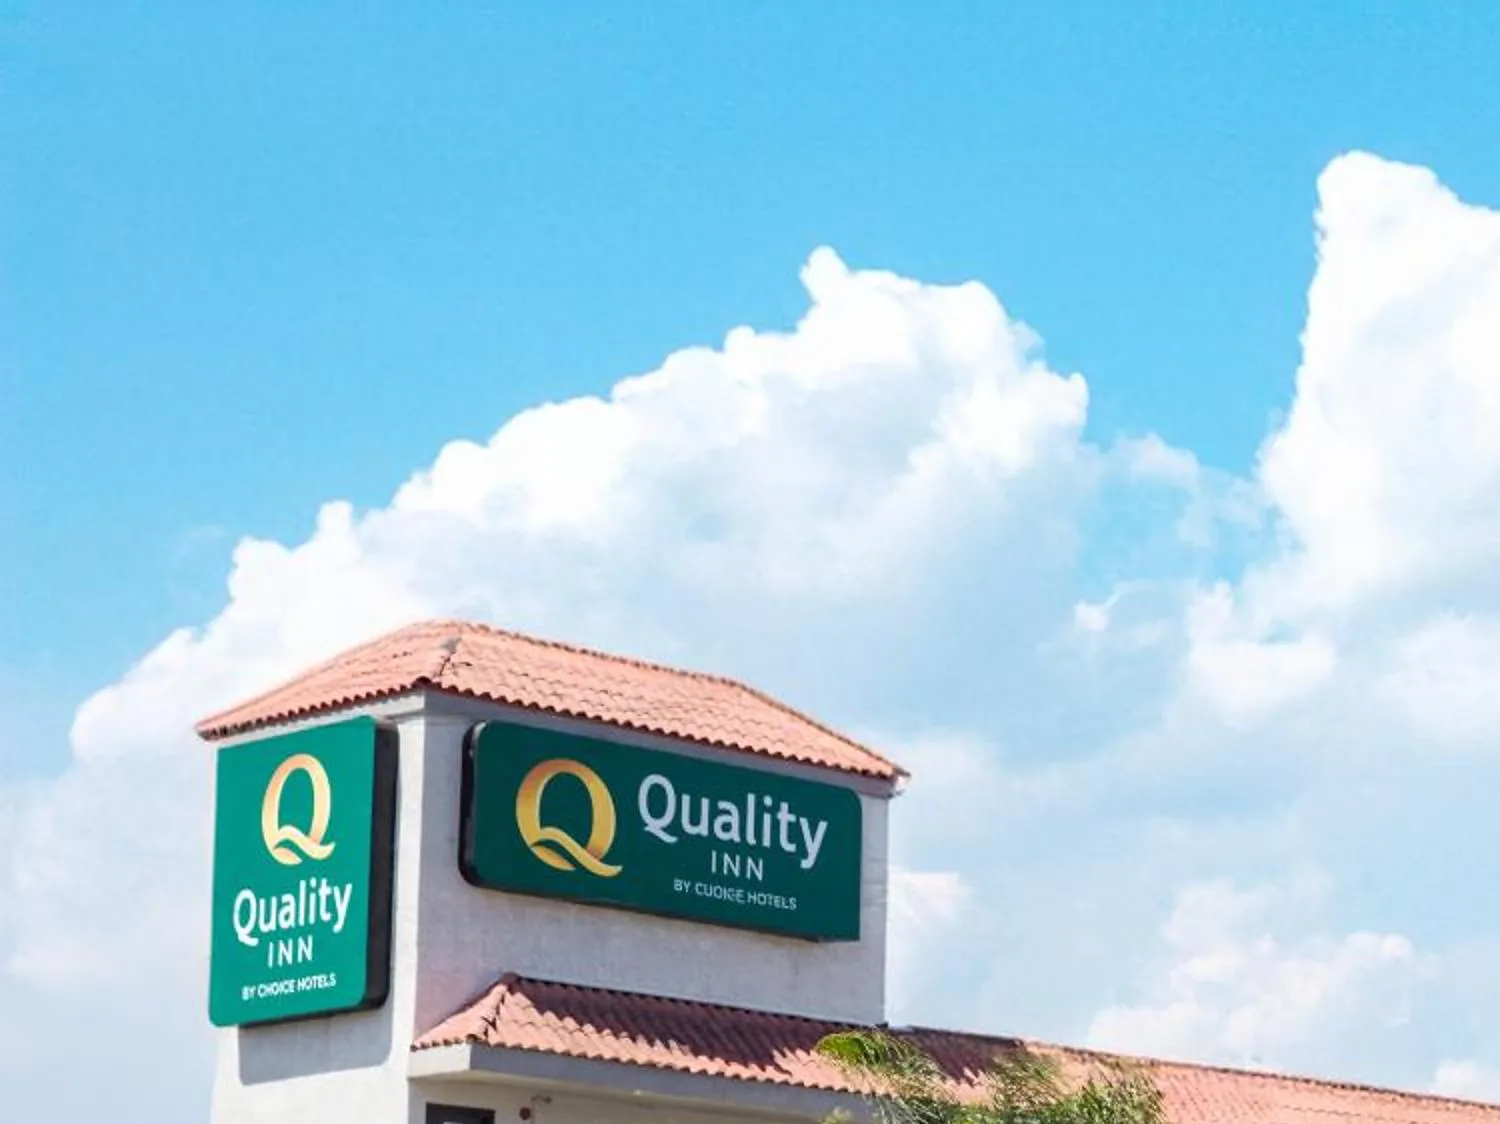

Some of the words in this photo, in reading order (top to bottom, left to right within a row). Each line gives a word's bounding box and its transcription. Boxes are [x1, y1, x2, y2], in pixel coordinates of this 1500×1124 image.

[262, 753, 336, 865] Q
[516, 758, 623, 877] Q
[638, 774, 828, 869] Quality
[711, 850, 764, 881] INN
[233, 877, 352, 946] Quality
[673, 878, 691, 893] BY
[747, 891, 797, 910] HOTELS
[268, 935, 313, 968] INN
[242, 984, 256, 1000] BY
[258, 979, 295, 998] CHOICE
[297, 972, 337, 991] HOTELS
